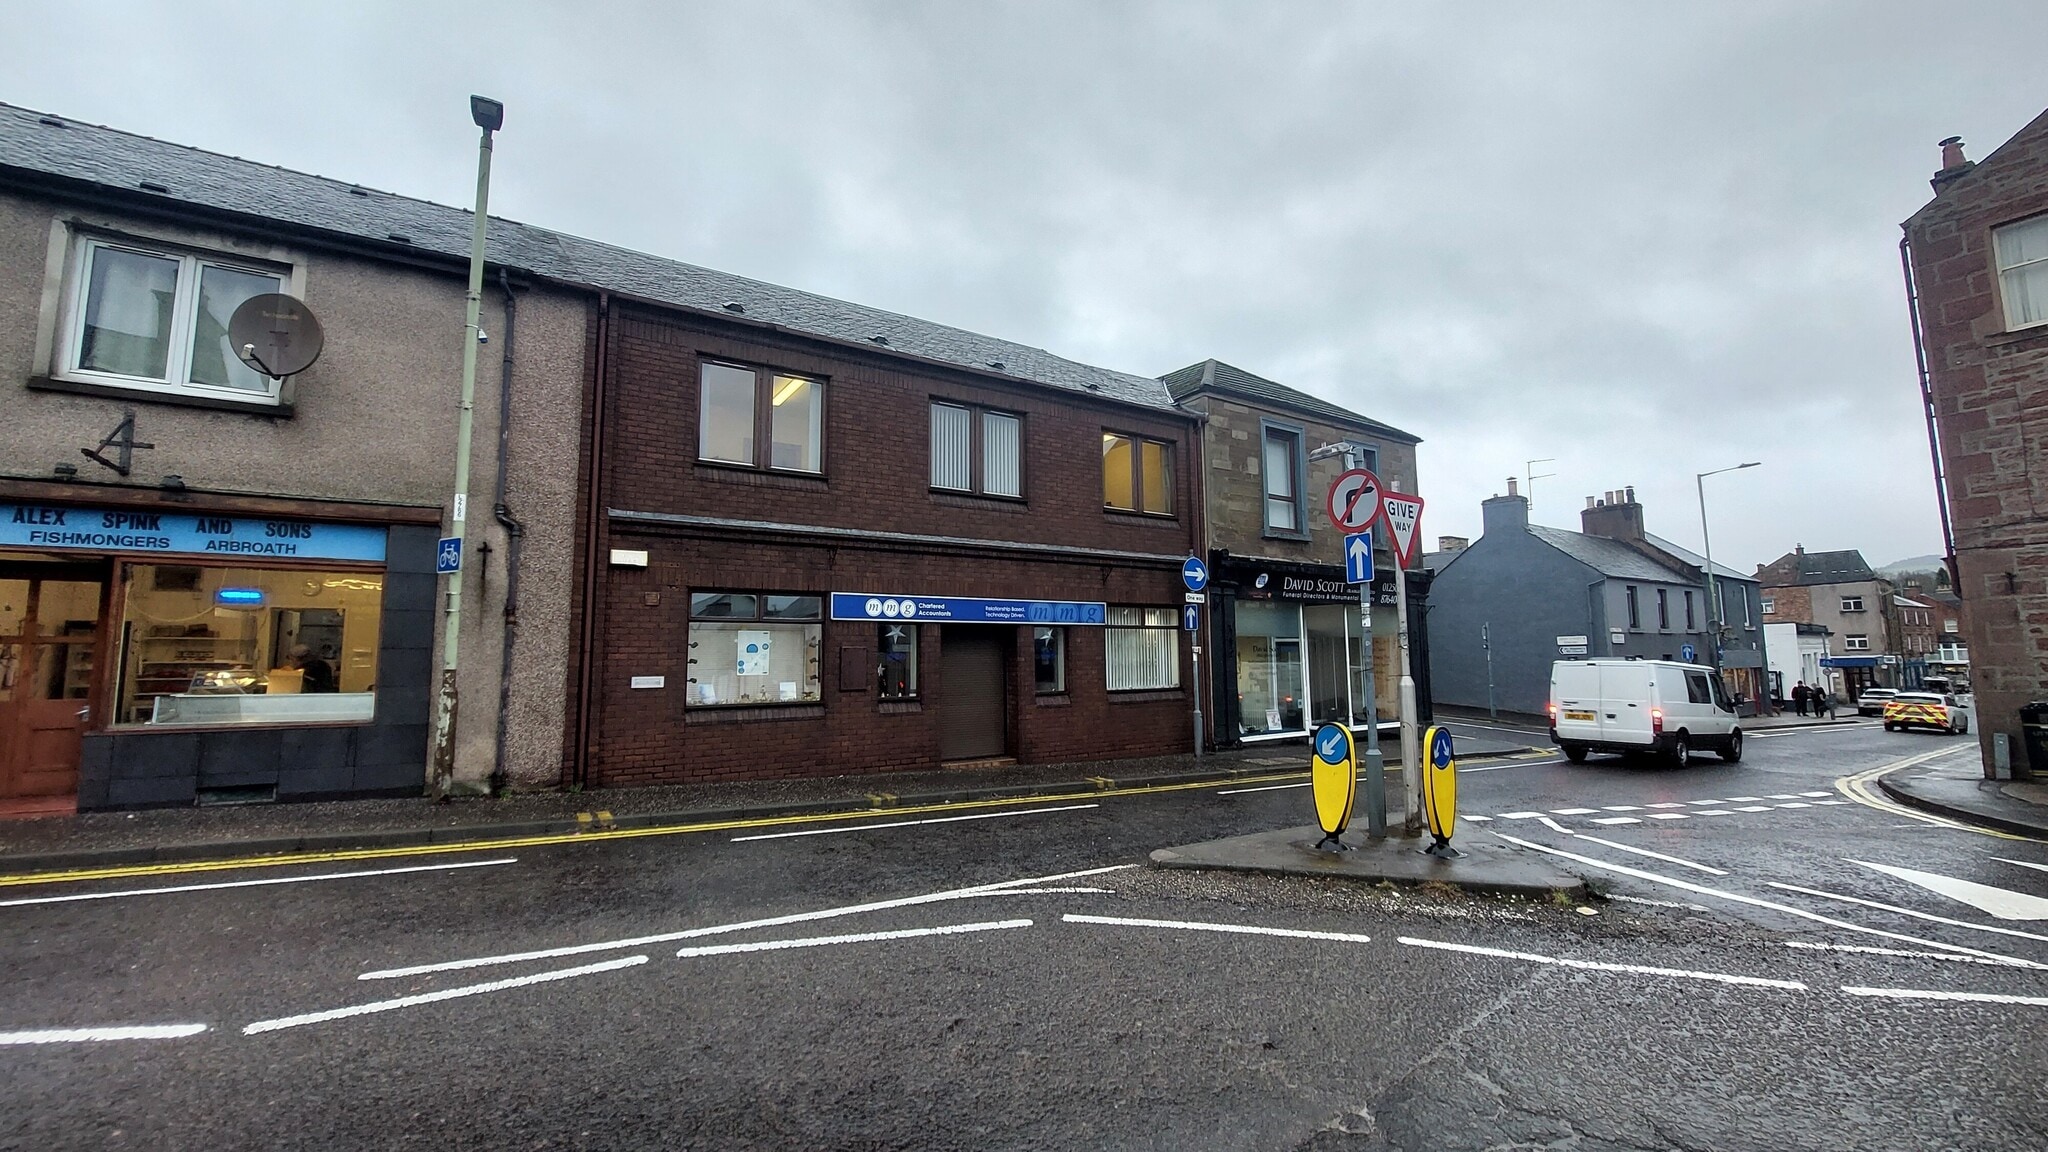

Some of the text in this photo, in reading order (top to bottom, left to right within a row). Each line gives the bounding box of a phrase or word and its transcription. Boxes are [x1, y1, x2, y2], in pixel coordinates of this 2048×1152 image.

[1388, 501, 1414, 519] GIVE
[12, 507, 312, 539] ALEX SPINK AND SONS
[1395, 521, 1411, 532] WAY
[29, 530, 297, 555] FISHMONGERS ARBROATH
[1283, 576, 1314, 592] DAVID
[1382, 583, 1397, 593] 0125
[1282, 591, 1302, 599] Funeral
[1302, 592, 1325, 600] Directors
[918, 602, 945, 610] Chartered
[985, 611, 1010, 619] Technology
